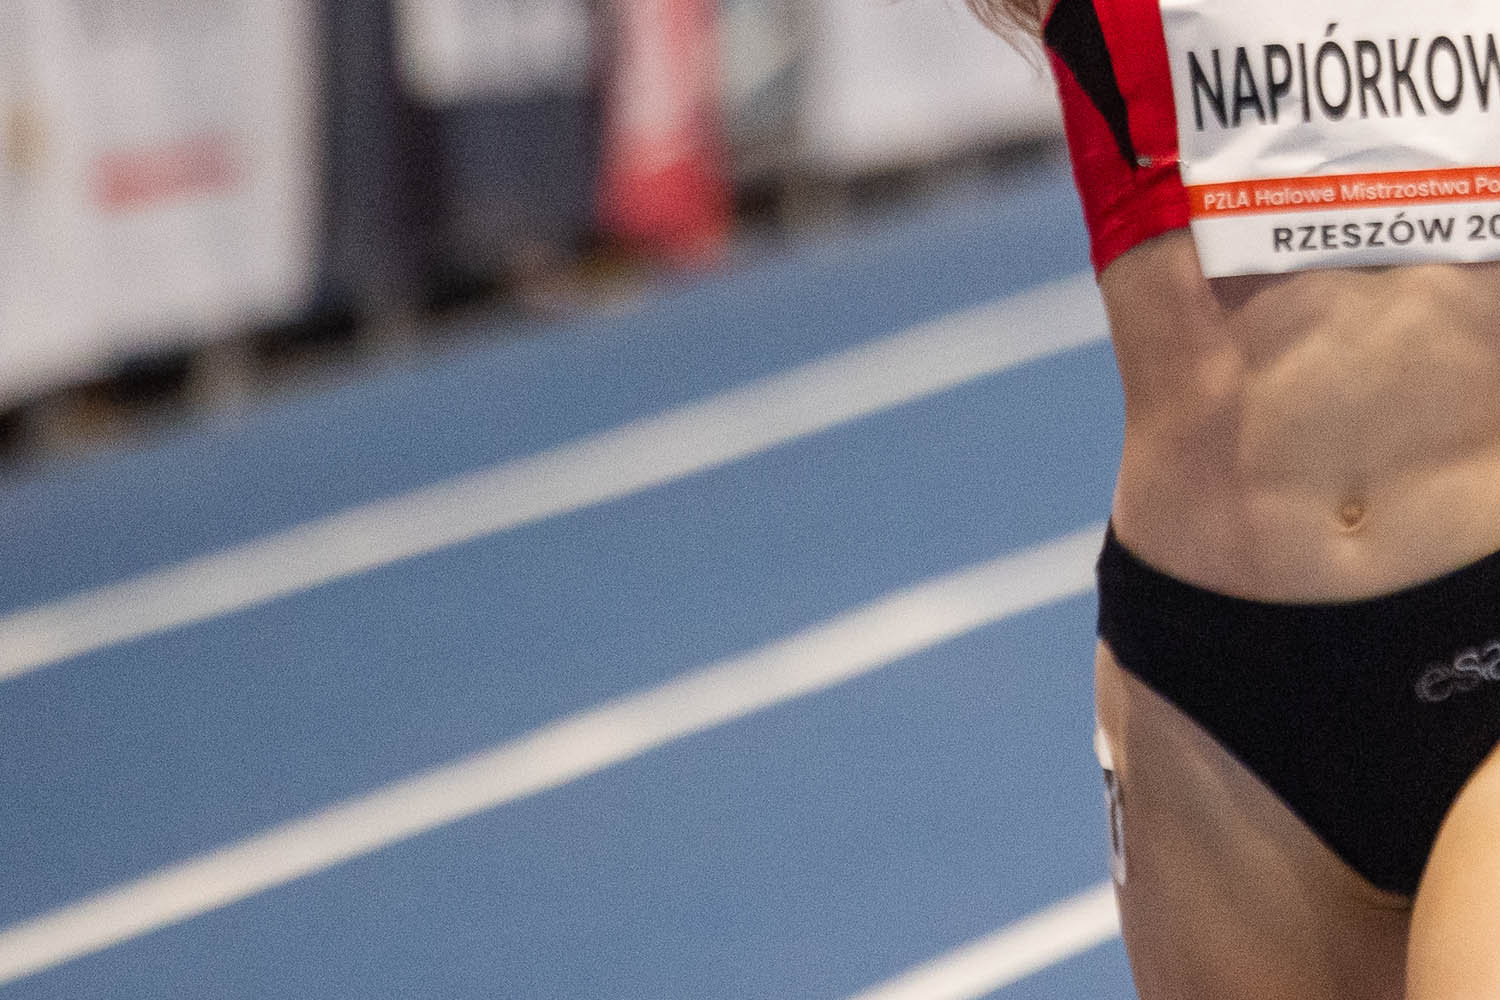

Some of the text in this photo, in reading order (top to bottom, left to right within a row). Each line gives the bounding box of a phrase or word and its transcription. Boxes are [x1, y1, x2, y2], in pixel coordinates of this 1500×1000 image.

[1204, 190, 1250, 211] PZLA
[1255, 186, 1336, 207] Halowe
[1340, 179, 1471, 201] Mistrzostwa
[1272, 211, 1455, 253] RZESZÓW
